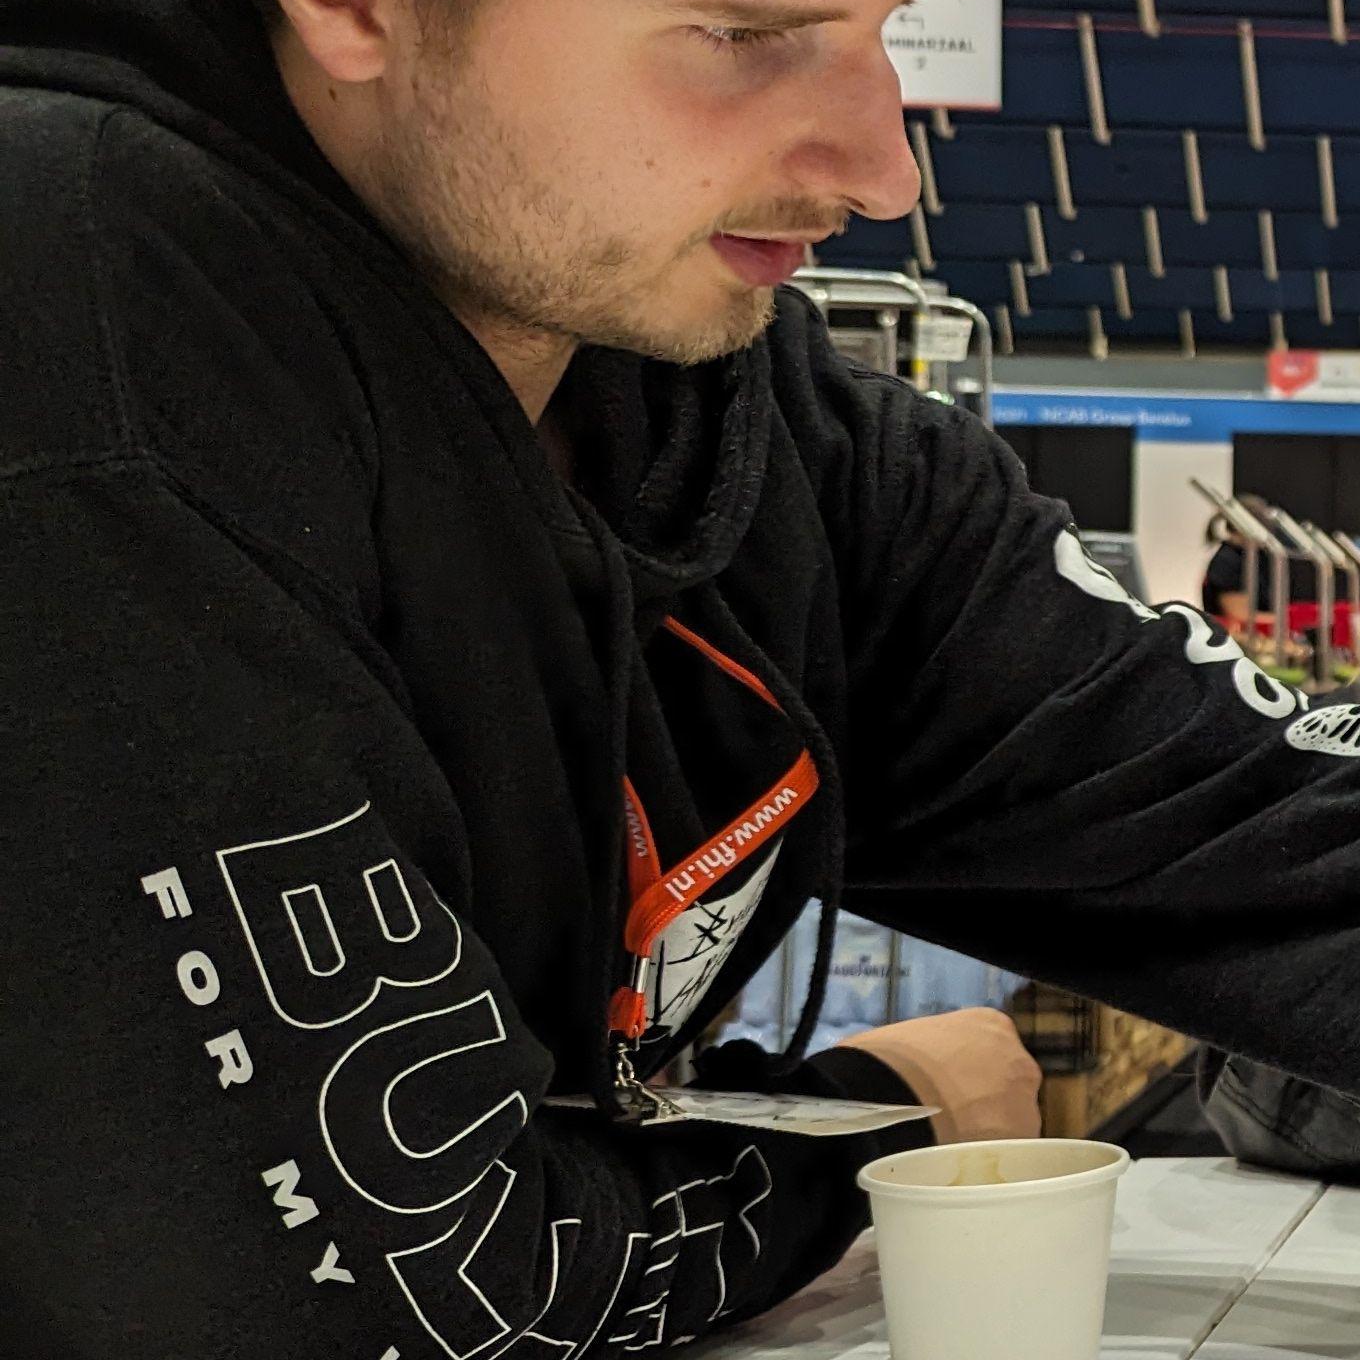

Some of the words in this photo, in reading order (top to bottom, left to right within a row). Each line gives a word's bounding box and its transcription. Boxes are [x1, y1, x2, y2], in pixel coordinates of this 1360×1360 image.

[665, 784, 800, 903] www.fhi.nl
[140, 865, 254, 1091] FOR
[260, 1157, 357, 1288] MY
